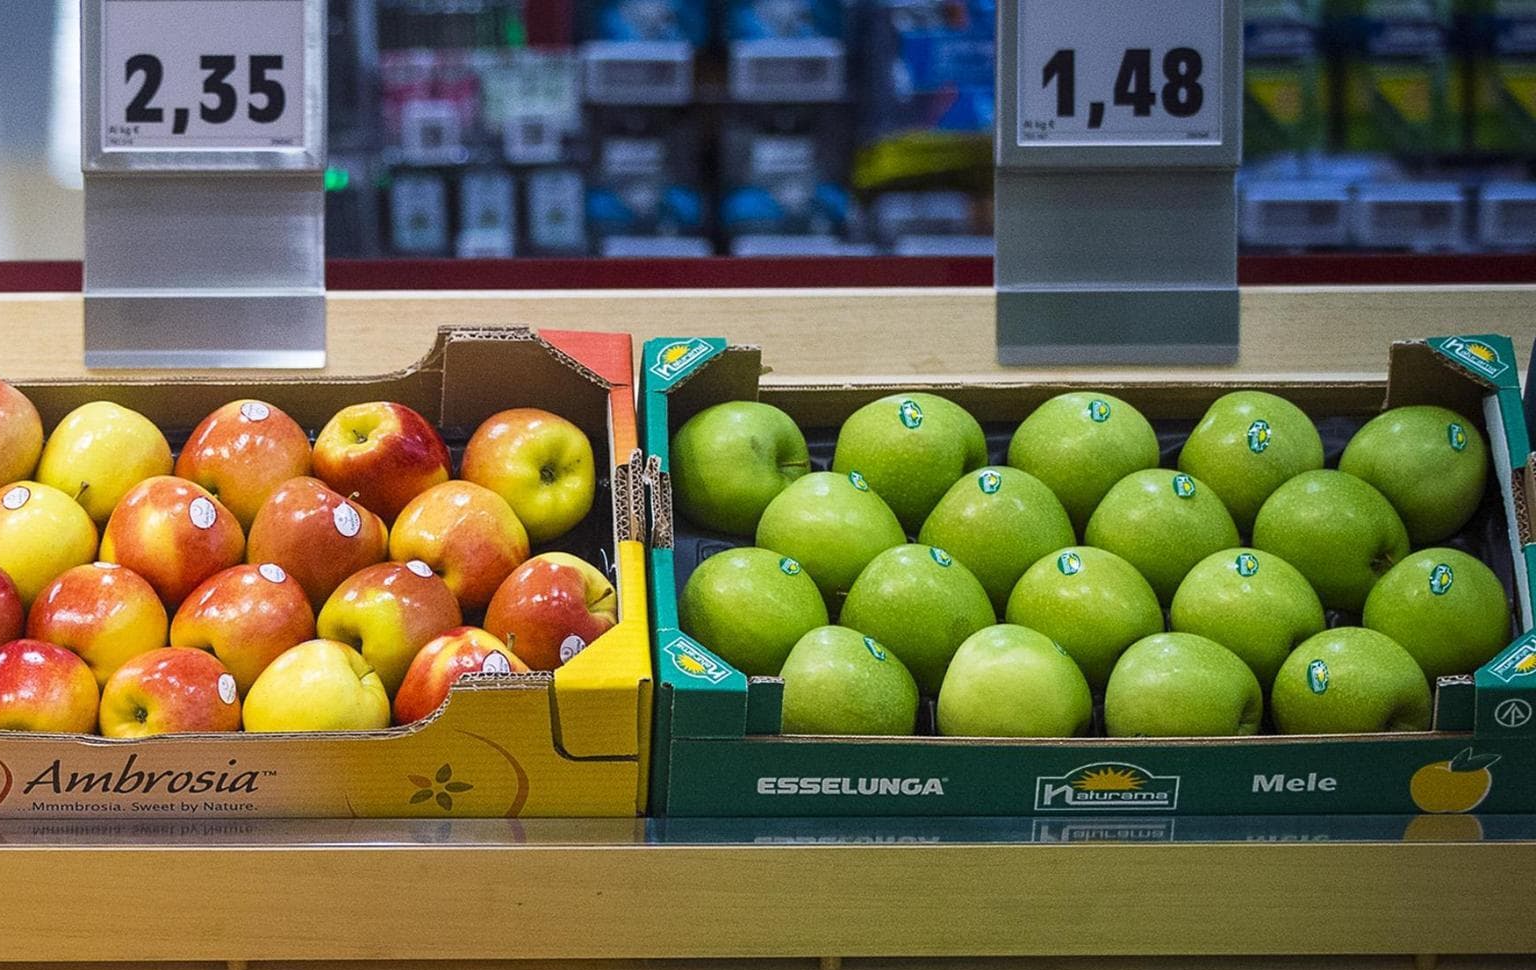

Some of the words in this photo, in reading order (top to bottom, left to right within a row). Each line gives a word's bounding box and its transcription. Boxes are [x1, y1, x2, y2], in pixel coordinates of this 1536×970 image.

[124, 53, 287, 135] 2,35
[1041, 47, 1205, 129] 1,48
[756, 776, 945, 796] ESSELUNGA
[1251, 771, 1338, 793] Mele
[131, 801, 176, 813] Sweet
[180, 801, 199, 814] by
[203, 801, 259, 813] Nature.
